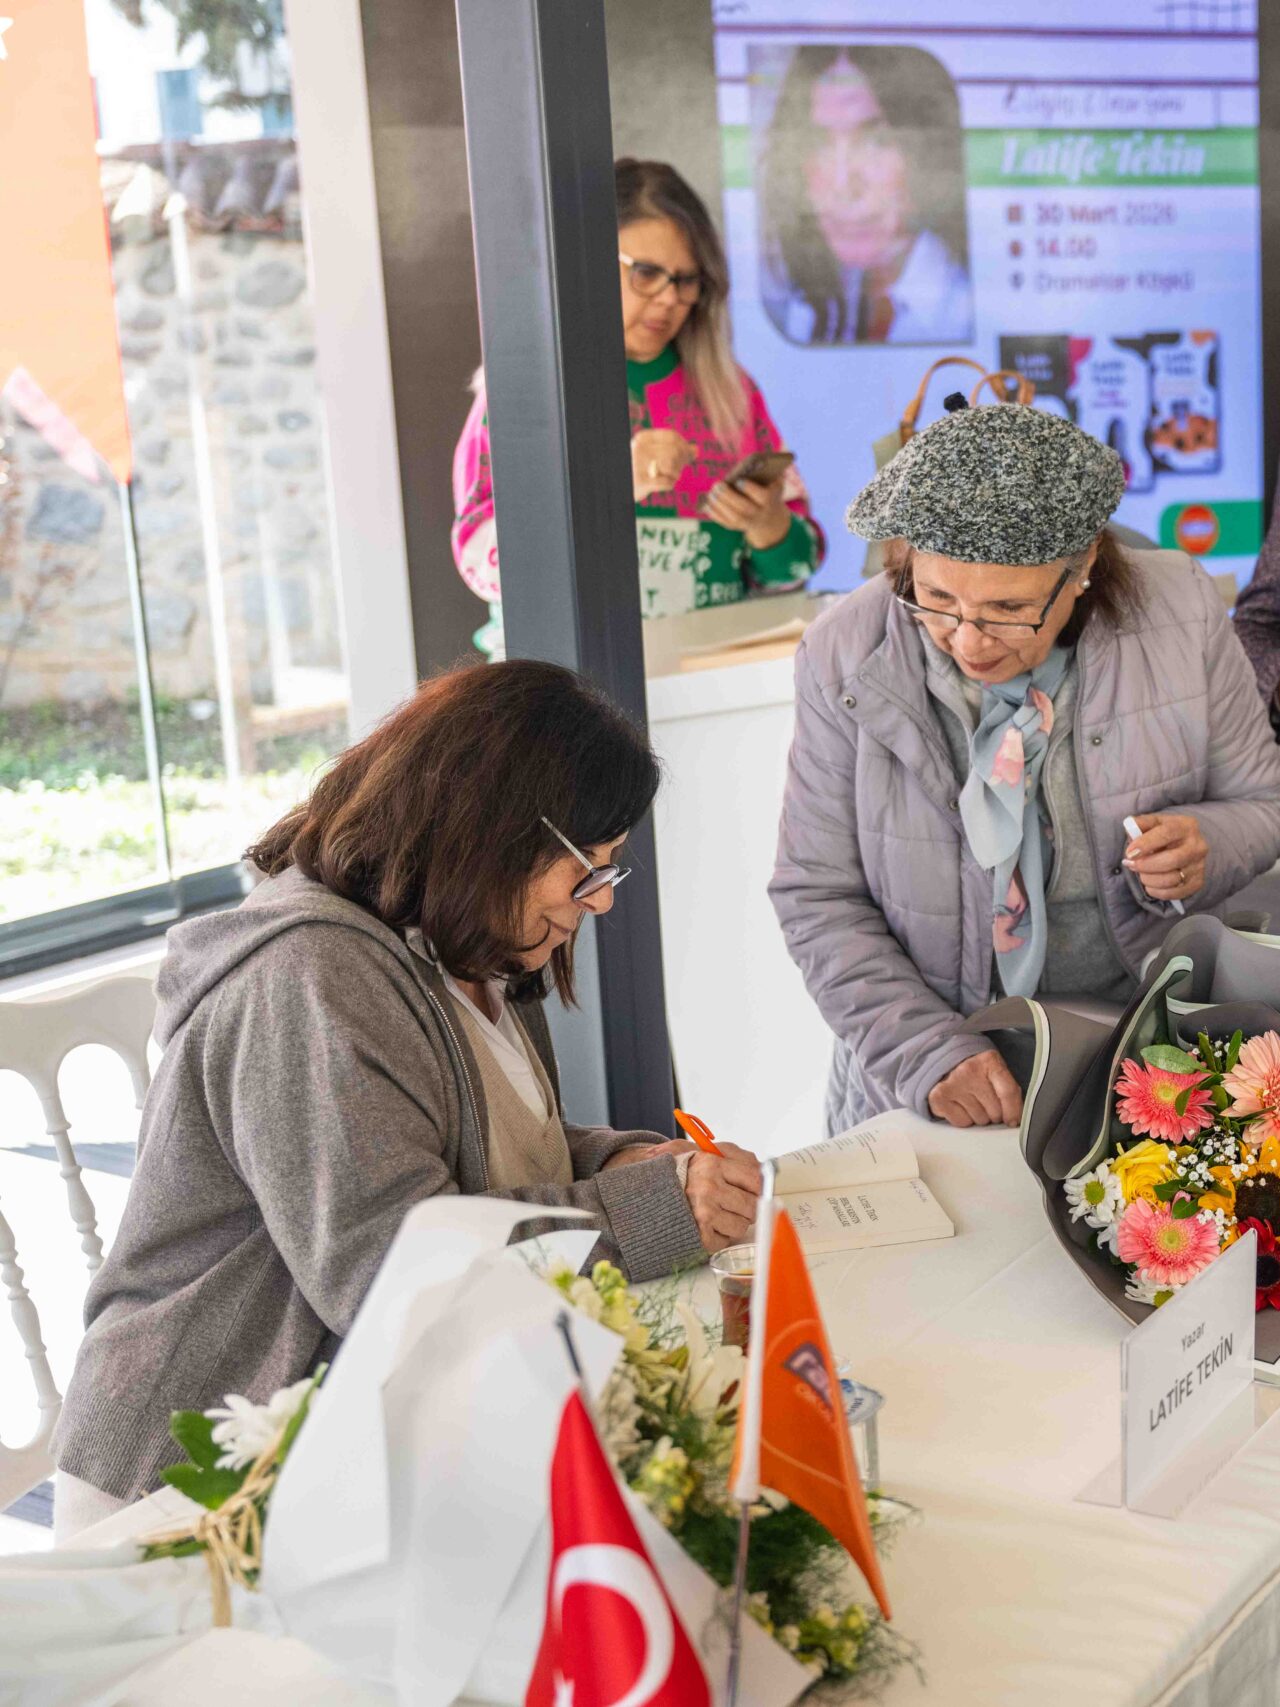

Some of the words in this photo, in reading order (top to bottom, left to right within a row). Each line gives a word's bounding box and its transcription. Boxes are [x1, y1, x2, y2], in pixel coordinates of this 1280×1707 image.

[1001, 132, 1104, 184] Latife
[1109, 130, 1206, 177] Tekin
[1068, 203, 1117, 224] Mart
[1181, 1322, 1206, 1353] Yazar
[1149, 1369, 1194, 1433] LATİFE
[1196, 1332, 1234, 1386] TEKİN
